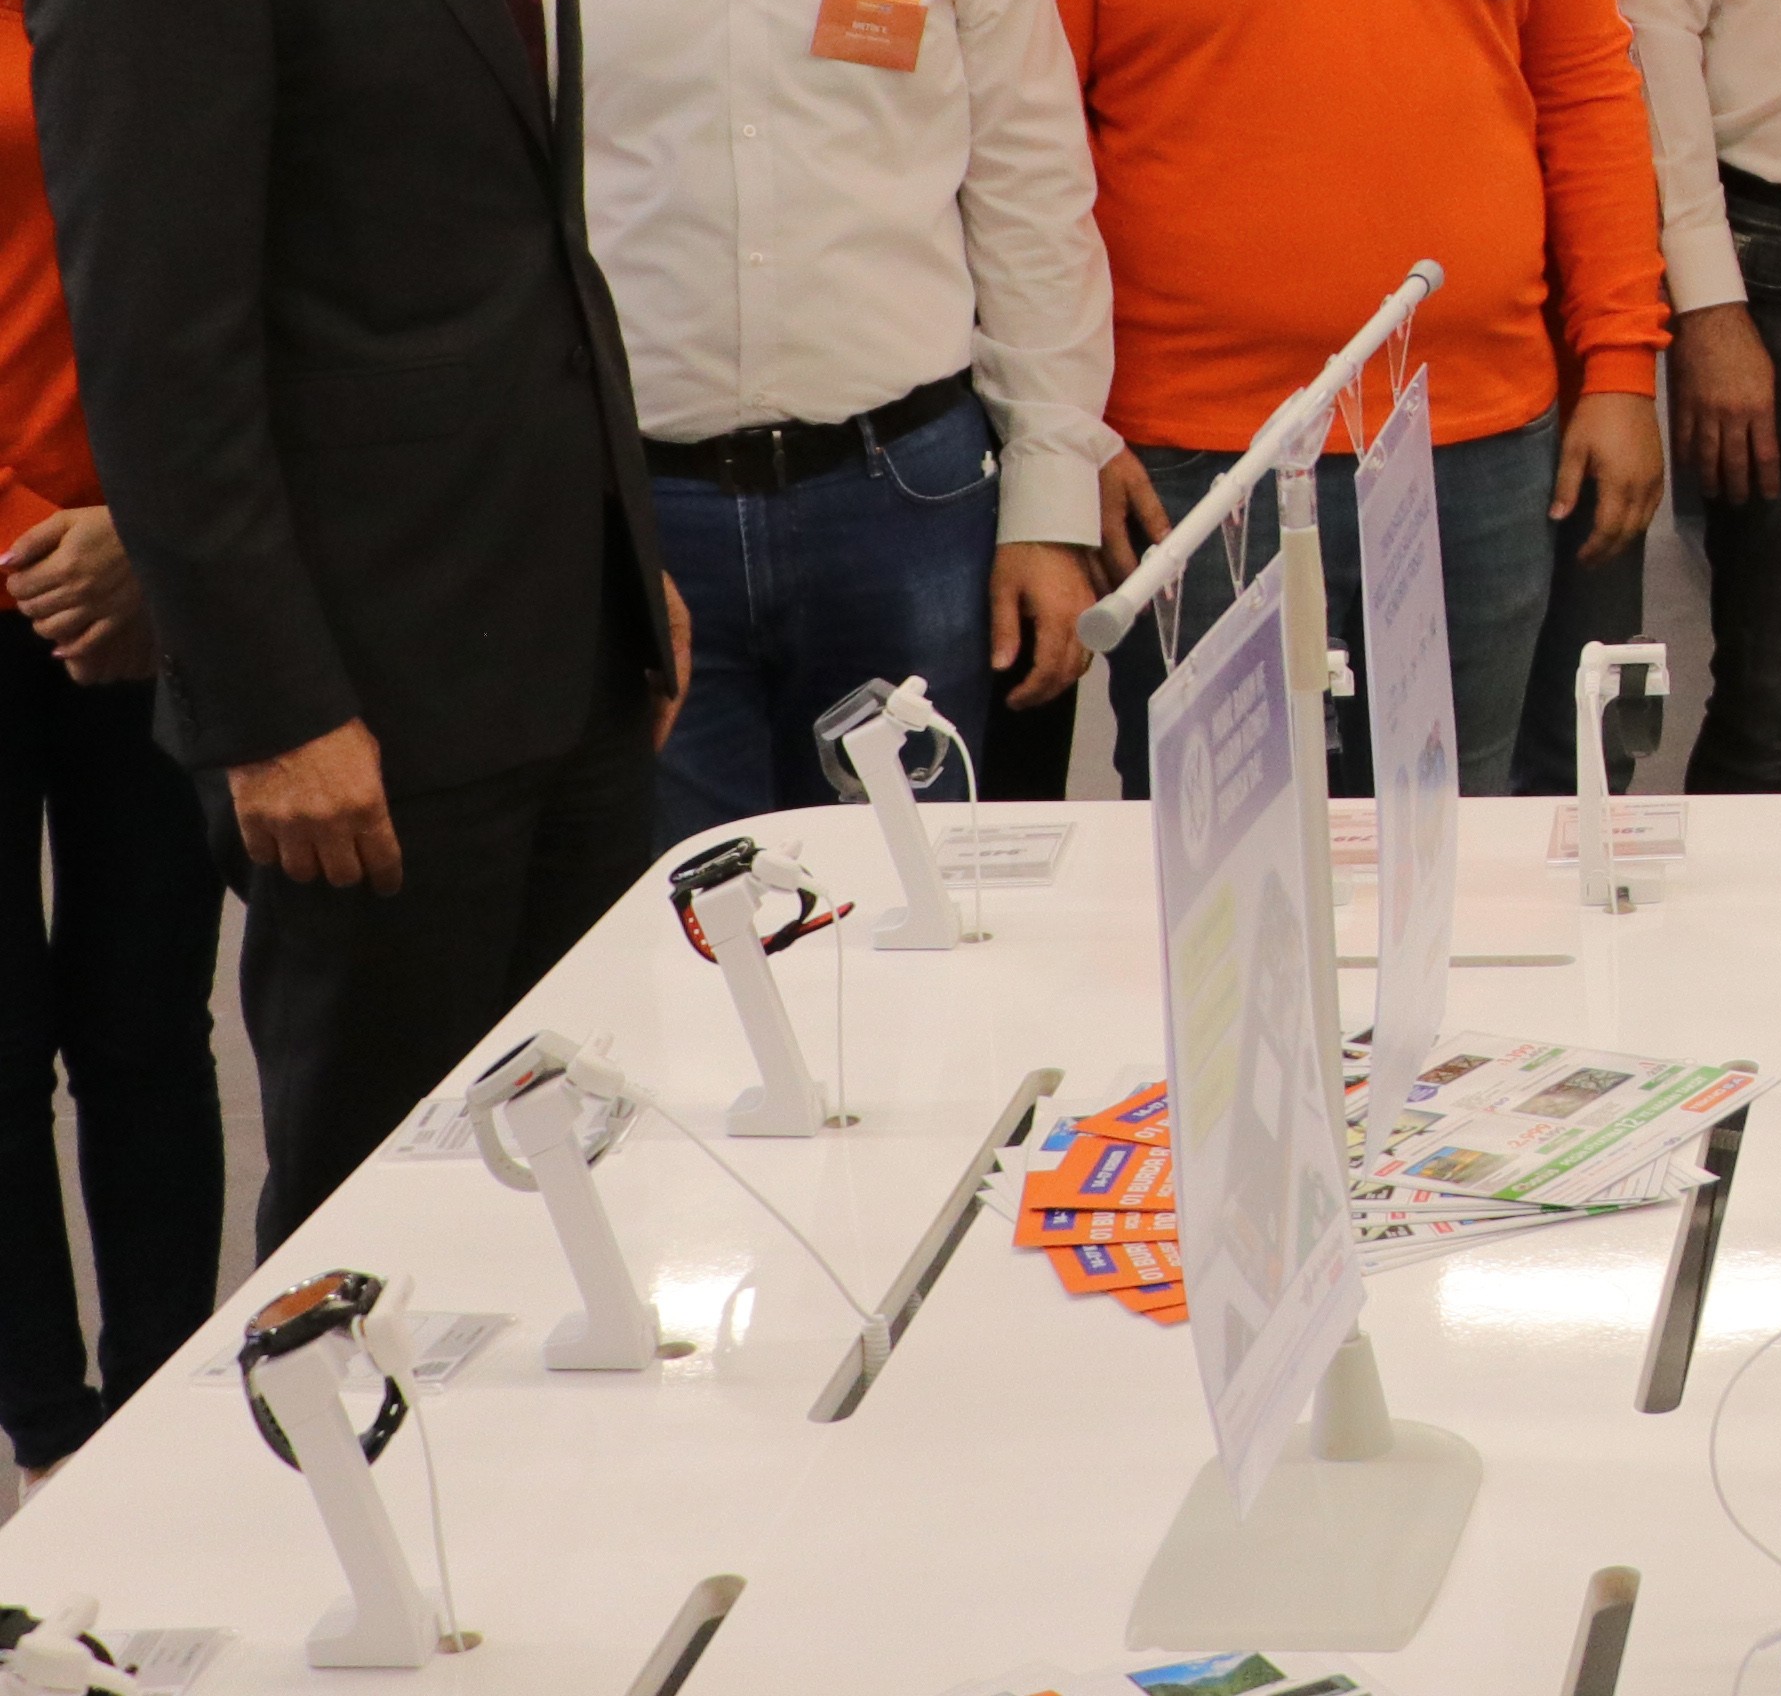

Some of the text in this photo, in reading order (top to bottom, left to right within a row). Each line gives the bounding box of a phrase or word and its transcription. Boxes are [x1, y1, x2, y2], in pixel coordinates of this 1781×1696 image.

[1119, 1158, 1166, 1206] 01 BURDA
[1089, 1211, 1116, 1241] 01 BU
[1138, 1267, 1164, 1281] 01
